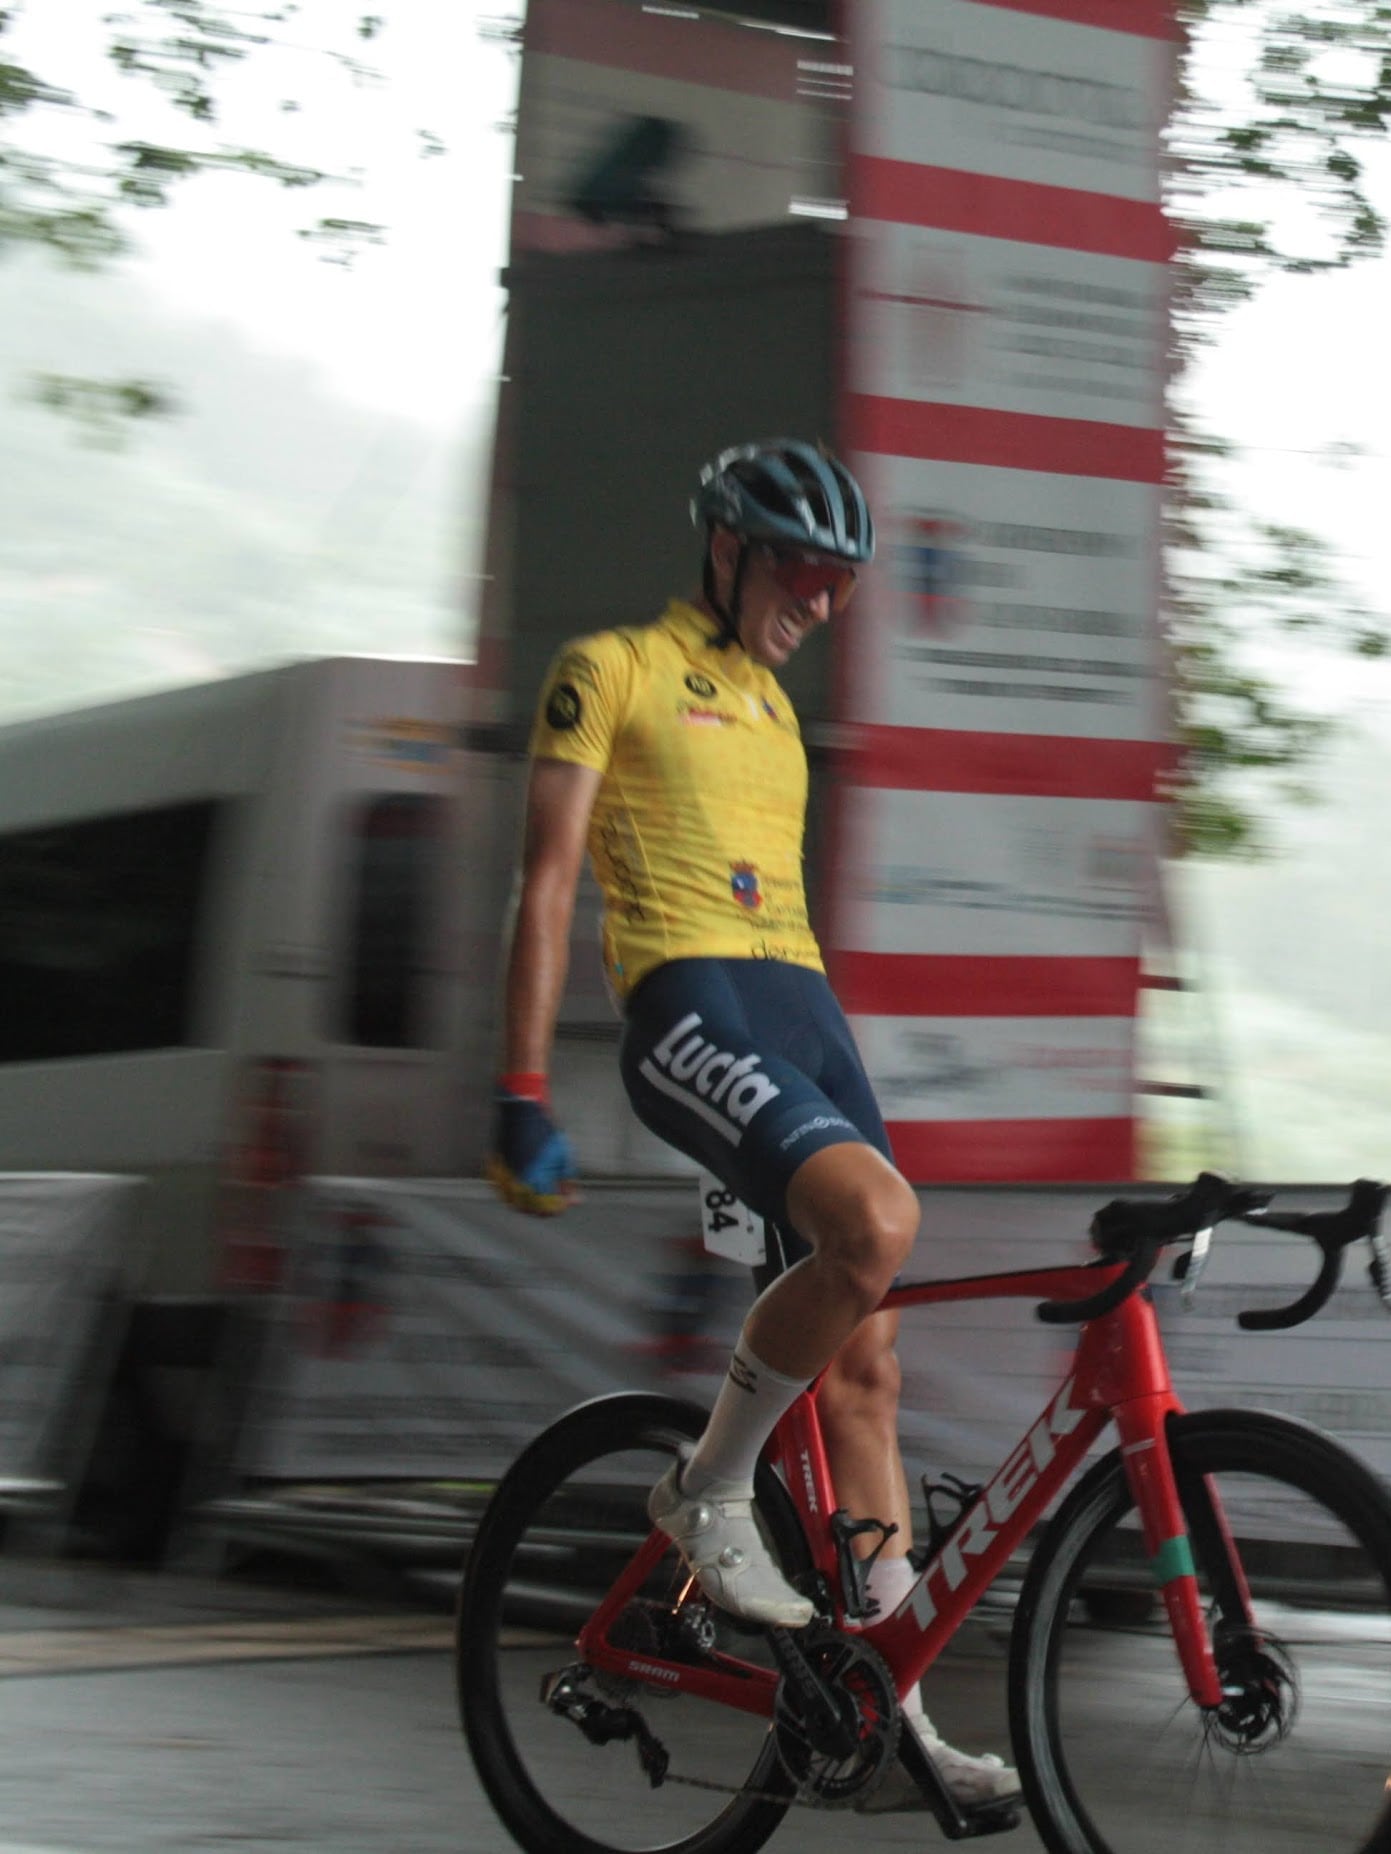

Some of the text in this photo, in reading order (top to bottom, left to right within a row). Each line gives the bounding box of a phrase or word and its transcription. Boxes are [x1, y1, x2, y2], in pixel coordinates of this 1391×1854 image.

[653, 1012, 781, 1127] Lucta
[705, 1190, 739, 1232] 84
[800, 1449, 818, 1513] TREK
[896, 1374, 1087, 1632] TREK
